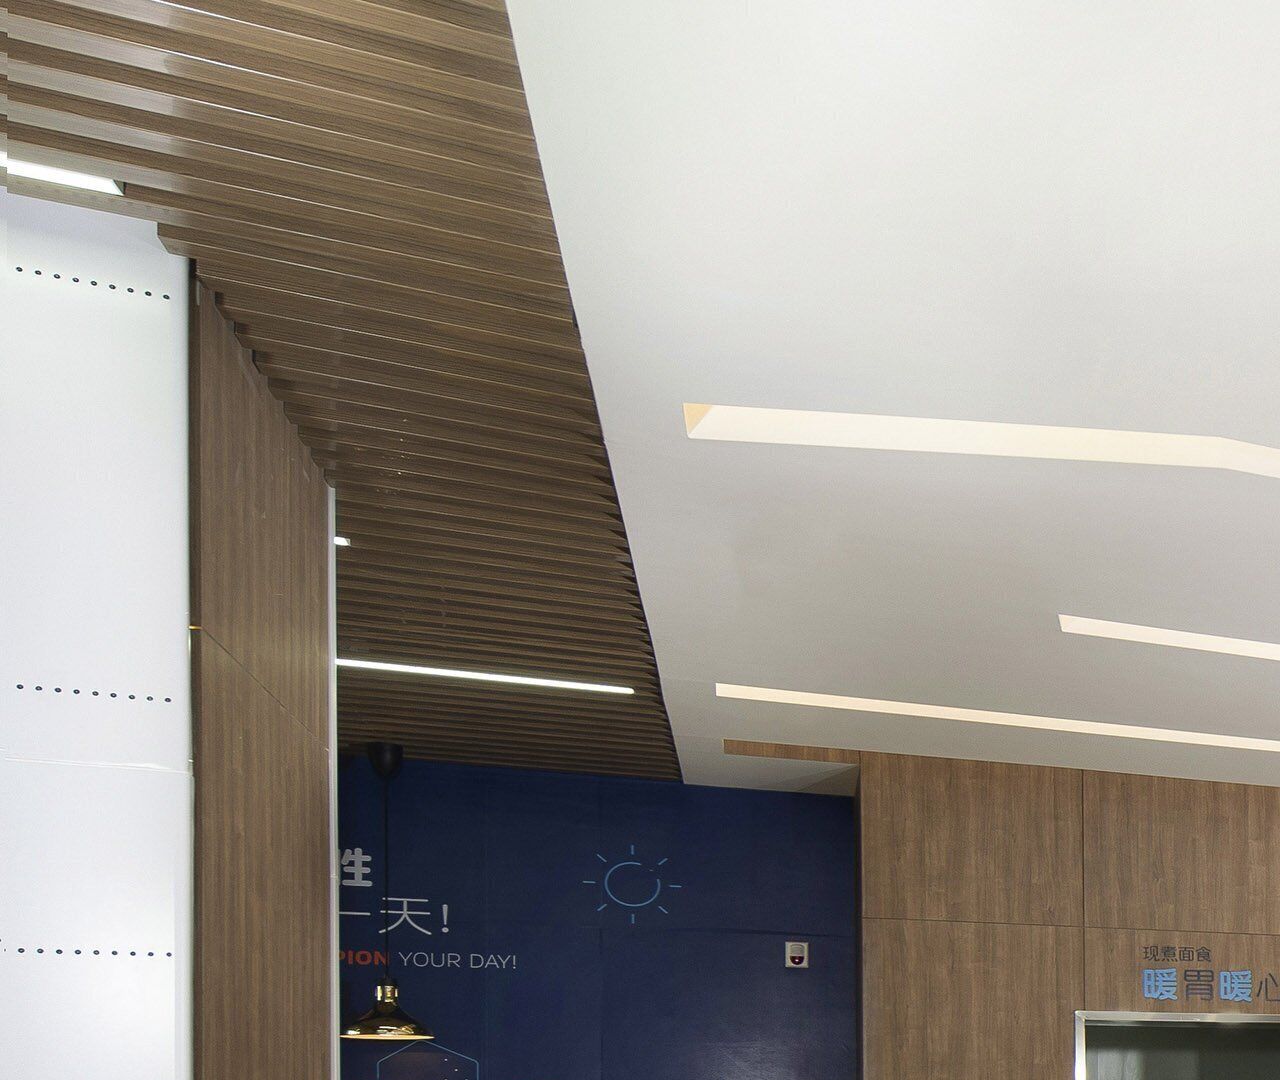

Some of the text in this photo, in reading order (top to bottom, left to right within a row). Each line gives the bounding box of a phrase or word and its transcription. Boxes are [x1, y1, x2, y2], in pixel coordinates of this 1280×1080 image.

[398, 951, 461, 968] YOUR
[470, 953, 516, 969] DAY!
[1142, 946, 1212, 962] 现煮面食
